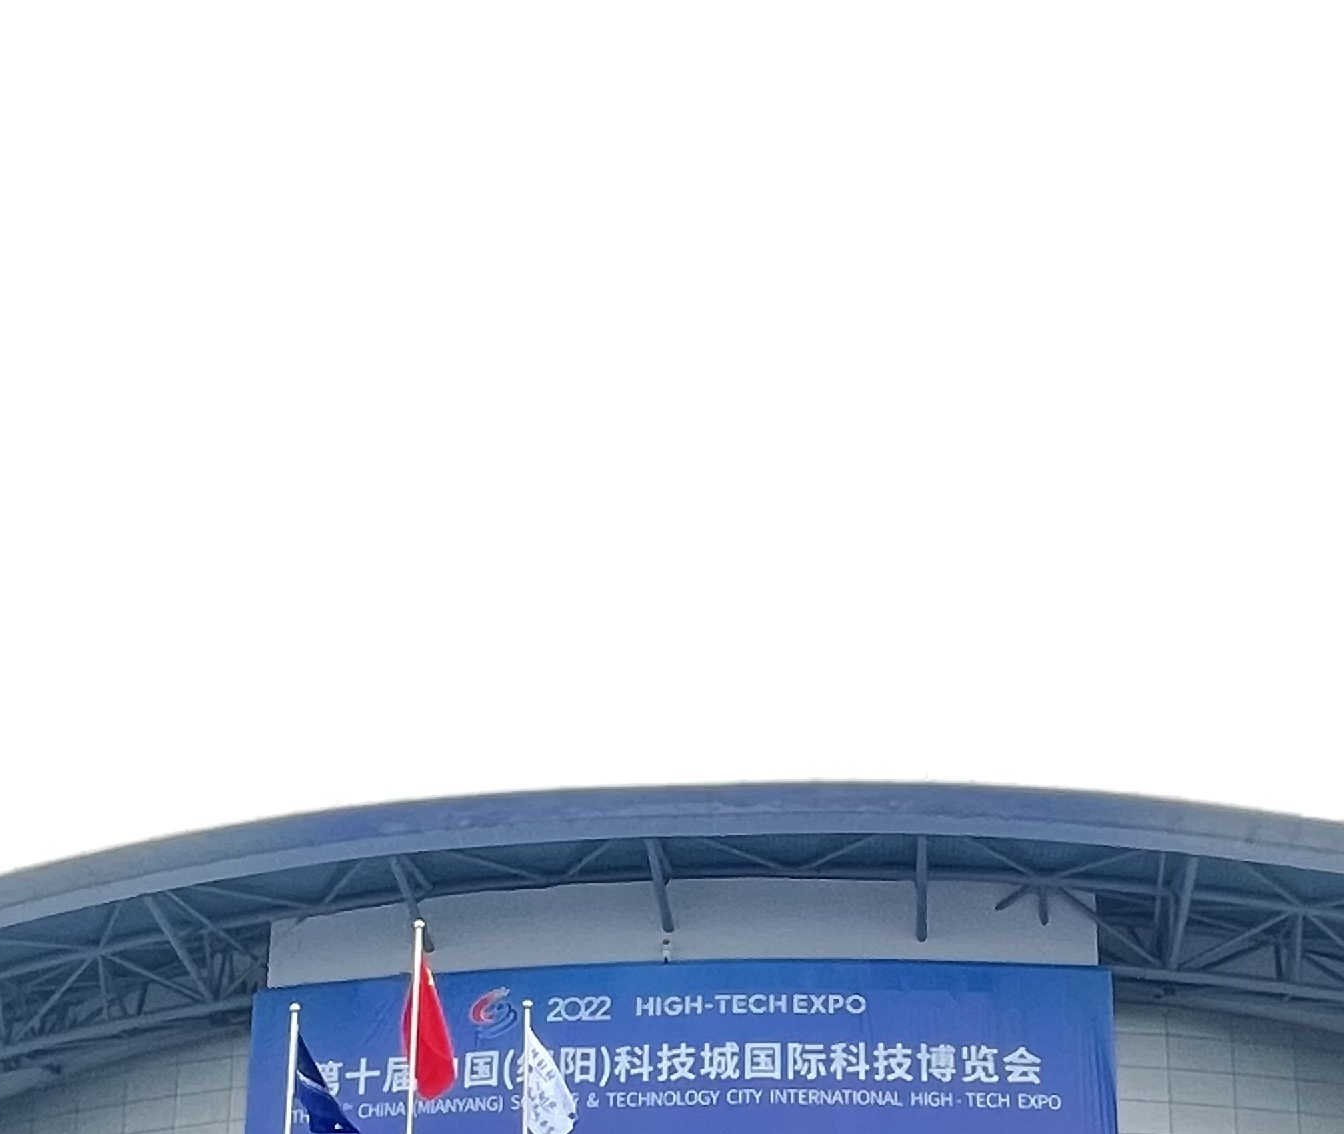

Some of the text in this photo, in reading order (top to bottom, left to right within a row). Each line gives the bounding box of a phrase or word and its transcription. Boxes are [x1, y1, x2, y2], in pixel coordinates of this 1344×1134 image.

[546, 993, 867, 1022] 2022 HIGH-TECH EXPO
[315, 1042, 1043, 1096] 第十届国(阳)科技城国际科技博览会
[358, 1102, 406, 1119] CHINA
[413, 1095, 504, 1118] (MIANYANG)
[586, 1093, 600, 1108] &
[608, 1089, 721, 1108] TECHNOLOGY
[726, 1089, 764, 1106] CITY
[769, 1089, 904, 1107] INTERNATIONAL
[1017, 1092, 1062, 1111] EXPO
